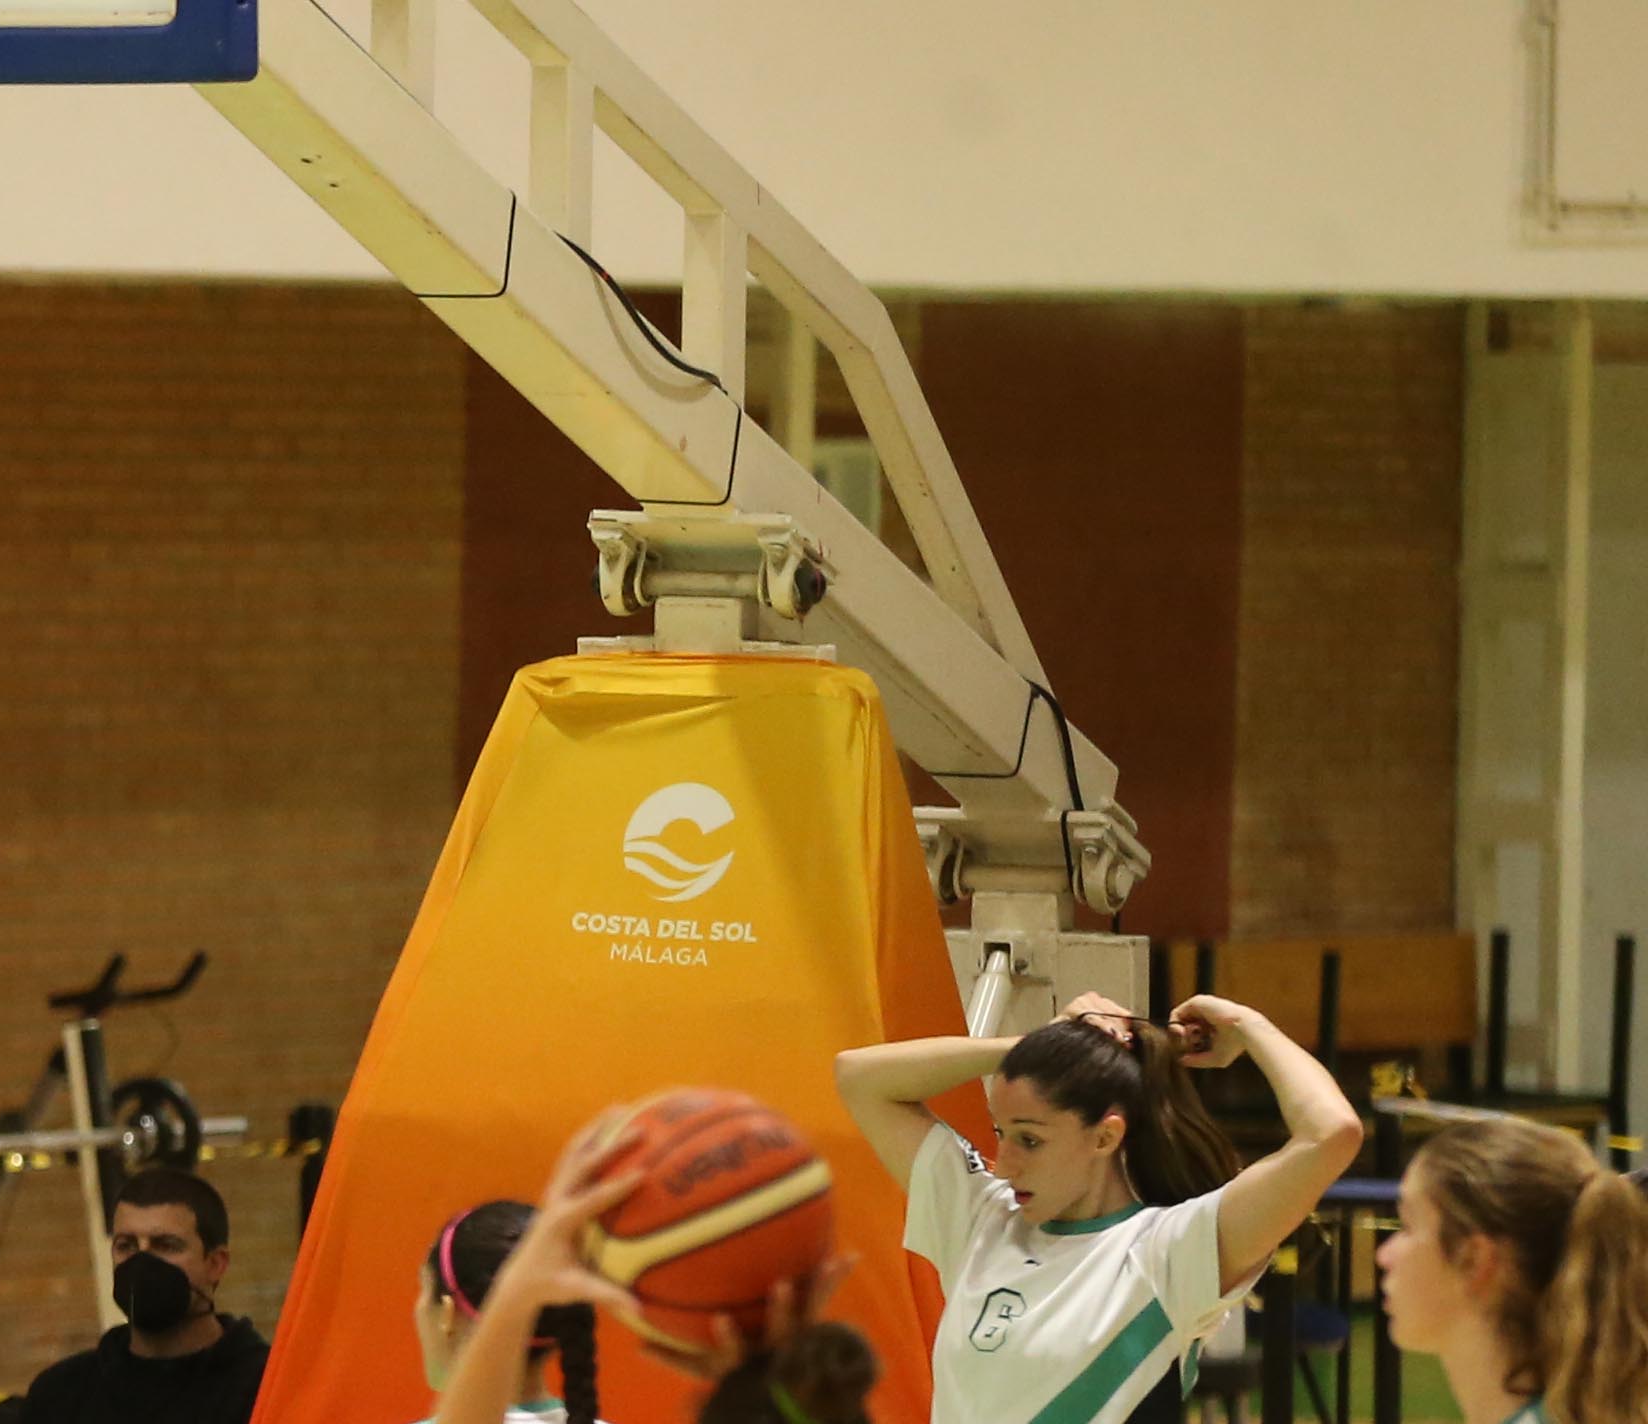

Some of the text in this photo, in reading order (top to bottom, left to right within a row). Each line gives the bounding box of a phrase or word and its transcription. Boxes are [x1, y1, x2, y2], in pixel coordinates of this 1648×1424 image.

[571, 911, 758, 943] COSTA DEL SOL
[609, 940, 708, 967] MÁLAGA
[968, 1287, 1028, 1353] 6
